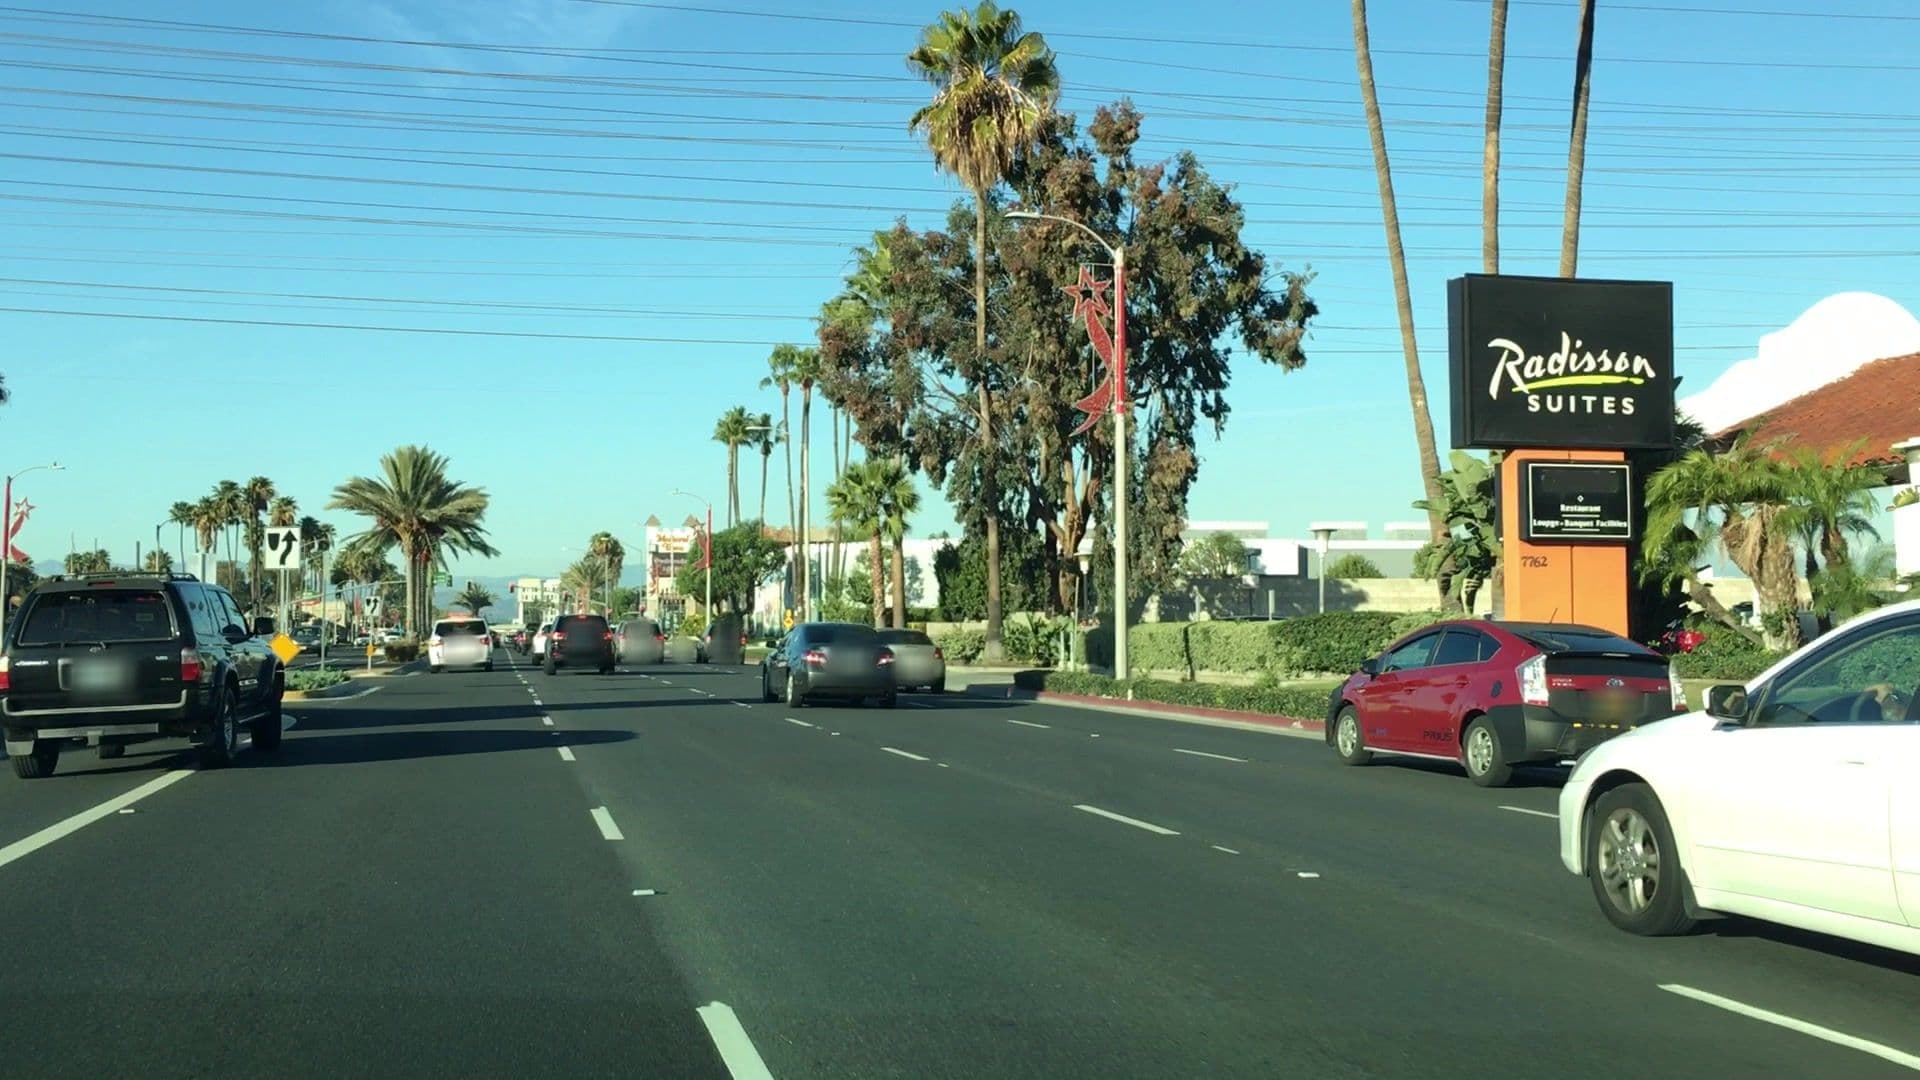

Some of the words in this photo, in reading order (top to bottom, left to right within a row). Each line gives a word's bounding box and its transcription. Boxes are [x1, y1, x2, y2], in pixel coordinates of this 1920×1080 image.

[1488, 331, 1656, 400] Radisson
[1528, 394, 1635, 415] SUITES
[1560, 504, 1601, 512] Restaurant
[1596, 519, 1628, 528] Facilities
[1521, 555, 1548, 568] 7762
[1423, 729, 1453, 741] PRIUS
